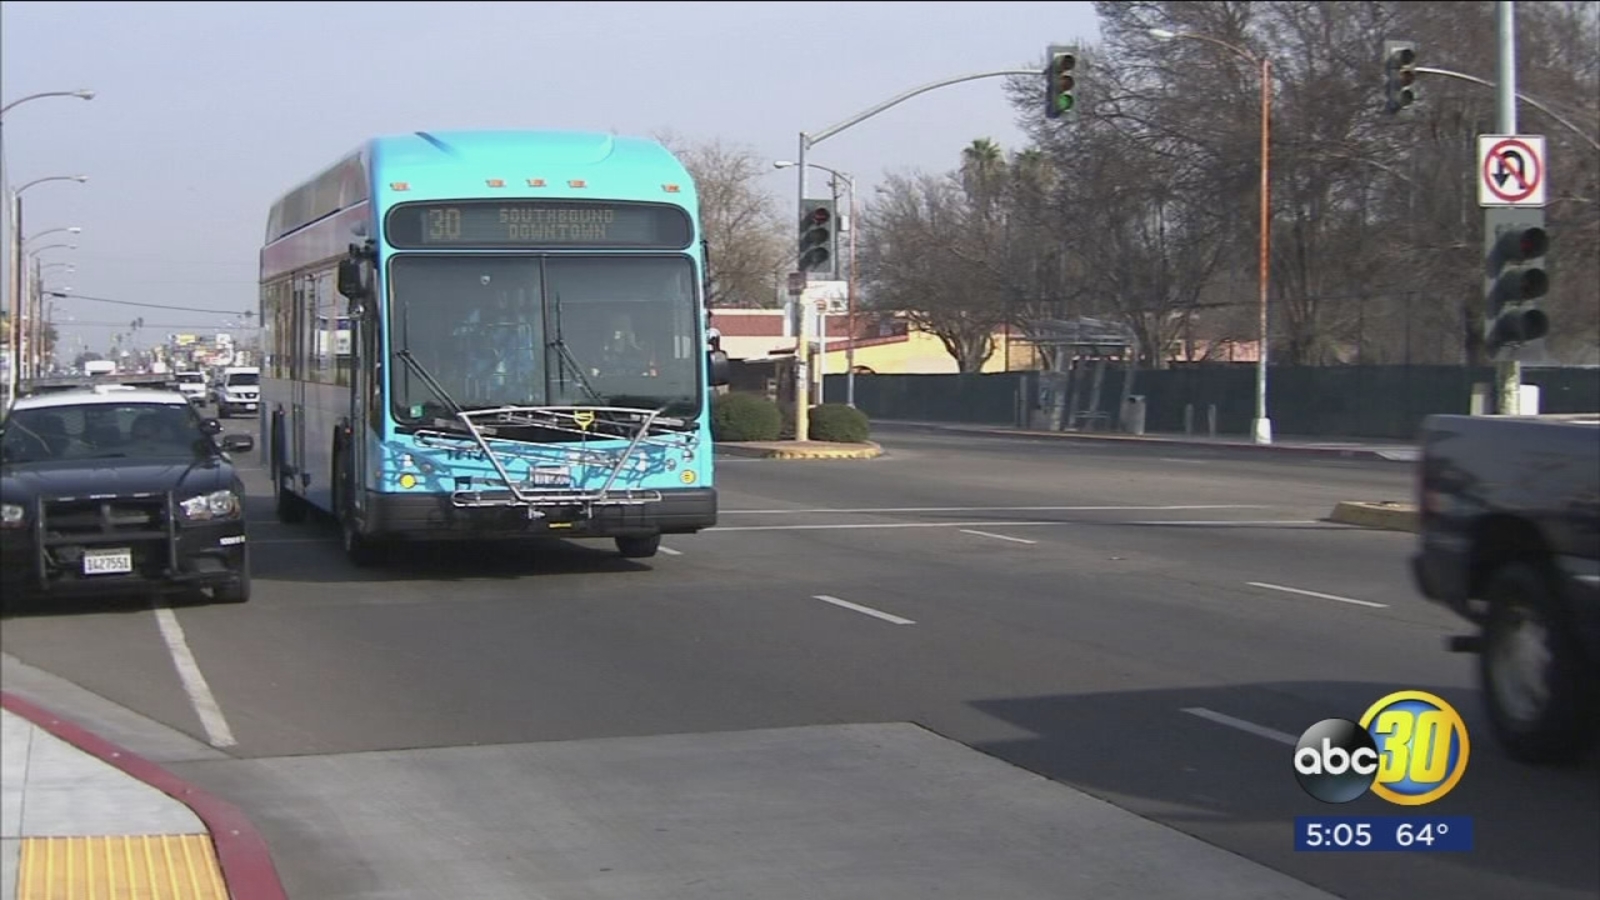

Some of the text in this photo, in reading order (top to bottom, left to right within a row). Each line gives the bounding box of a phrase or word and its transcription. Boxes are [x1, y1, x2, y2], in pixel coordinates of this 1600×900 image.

[500, 209, 614, 223] SOUTHBOUND
[429, 209, 461, 240] 30
[509, 224, 606, 240] DOWNTOWN
